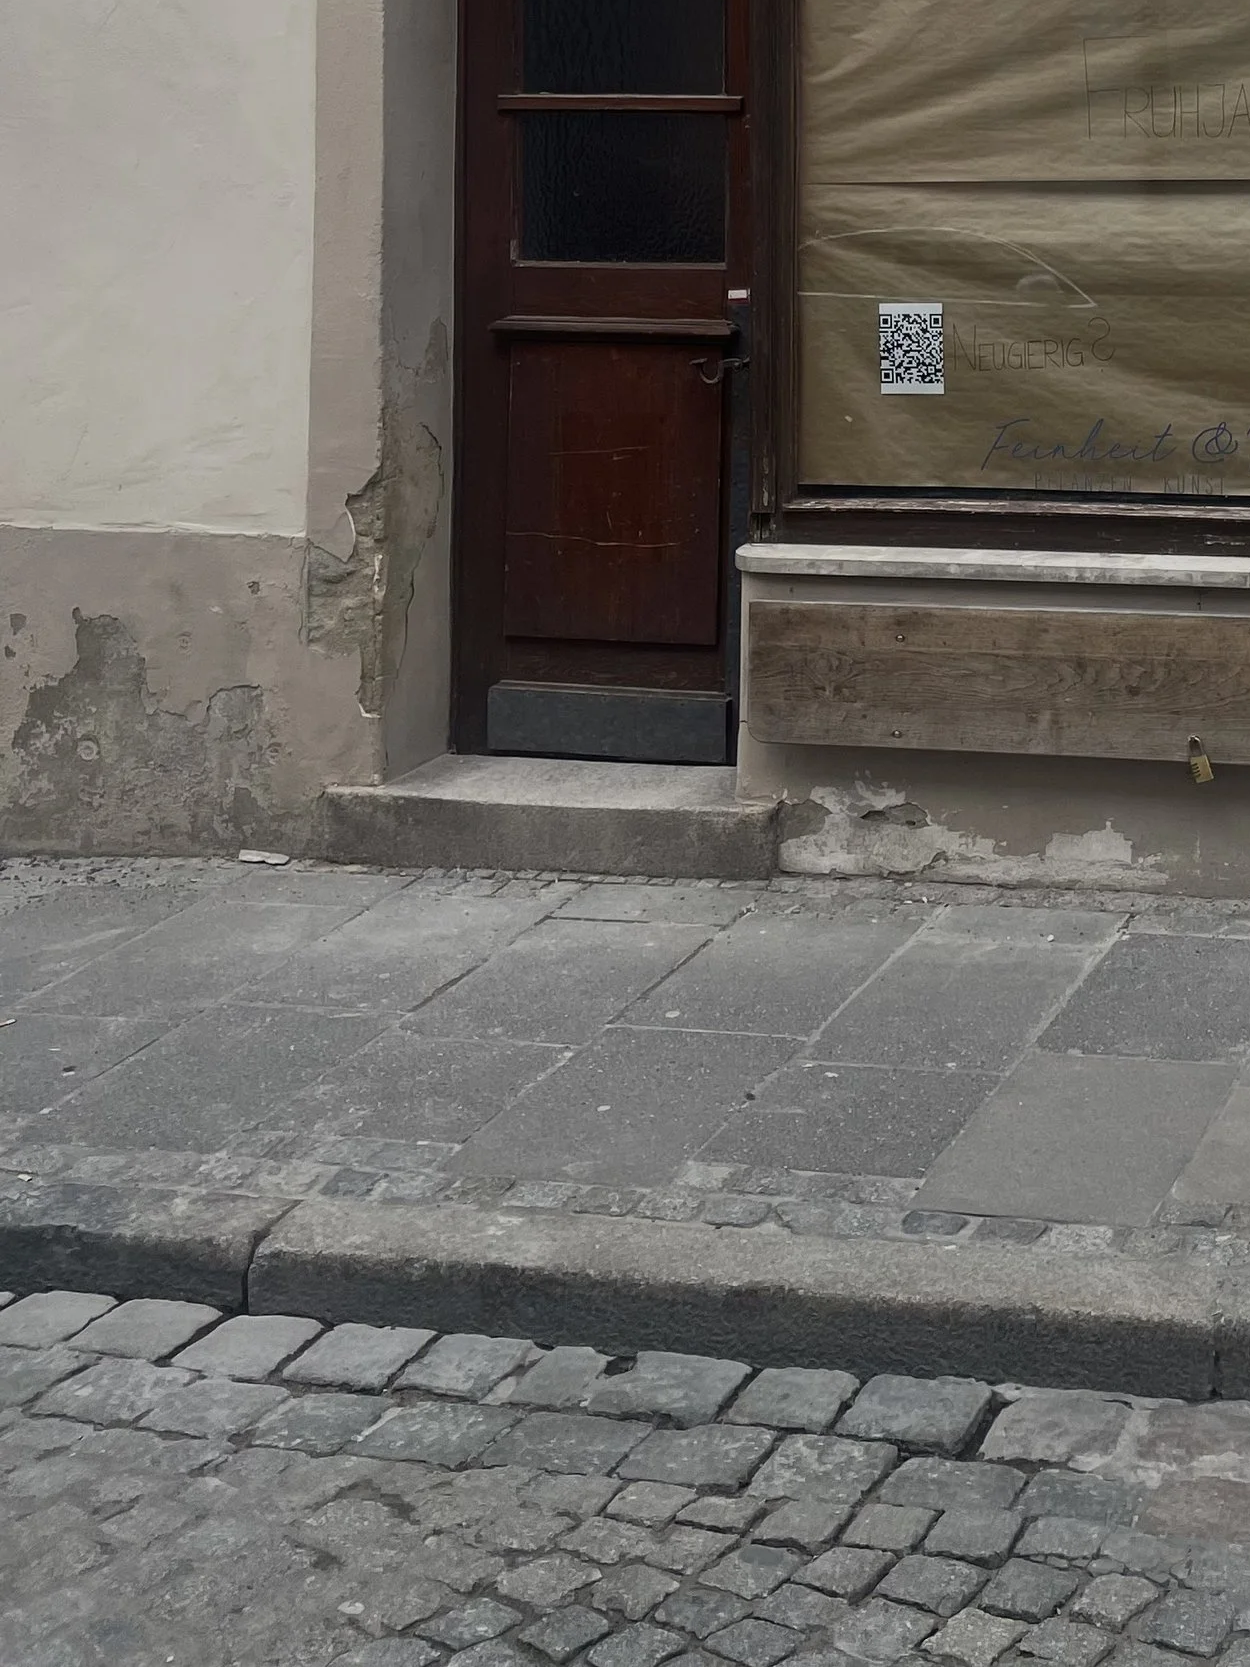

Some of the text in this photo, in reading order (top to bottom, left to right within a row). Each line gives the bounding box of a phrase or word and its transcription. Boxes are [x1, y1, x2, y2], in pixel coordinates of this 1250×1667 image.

[952, 316, 1116, 373] NEUGIERIG?
[980, 418, 1177, 471] Feinheit
[1191, 421, 1239, 465] &
[1162, 474, 1226, 495] KUNST
